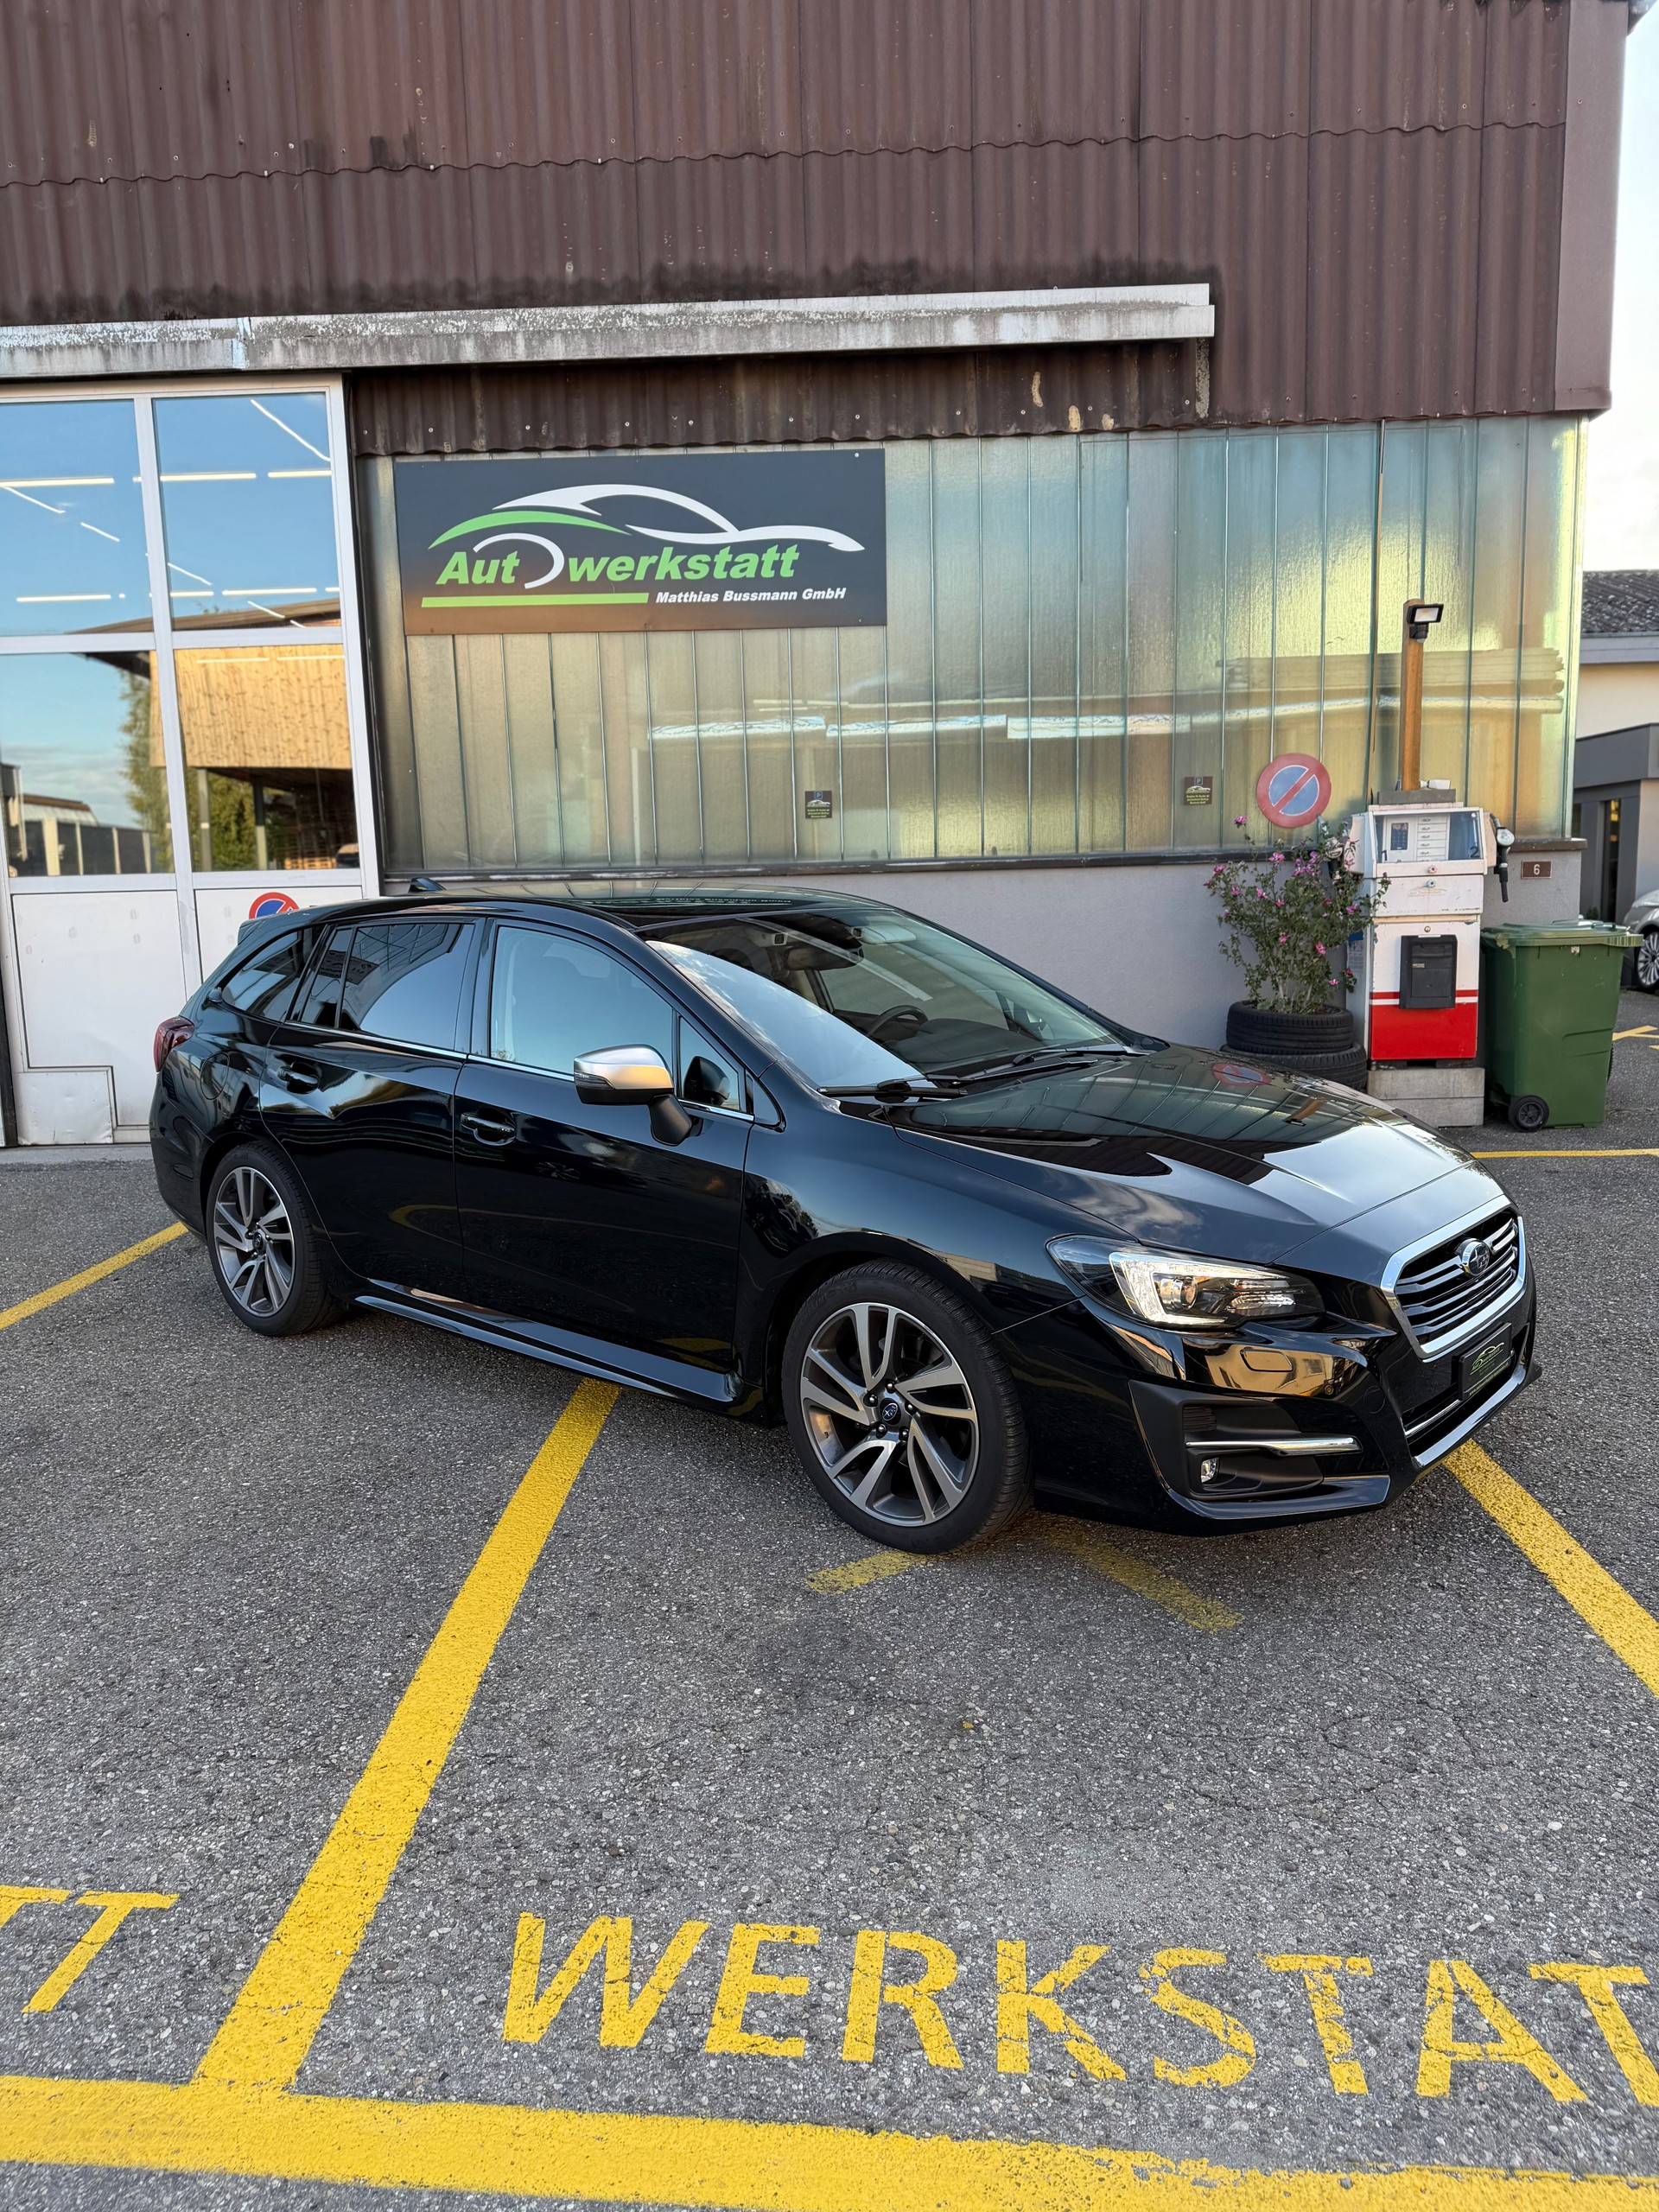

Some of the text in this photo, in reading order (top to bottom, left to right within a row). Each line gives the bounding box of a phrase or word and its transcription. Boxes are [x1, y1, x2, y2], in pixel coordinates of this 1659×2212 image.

[655, 588, 847, 604] Matthias Bussmann GmbH
[1470, 846, 1481, 858] 2
[1533, 863, 1541, 875] 6
